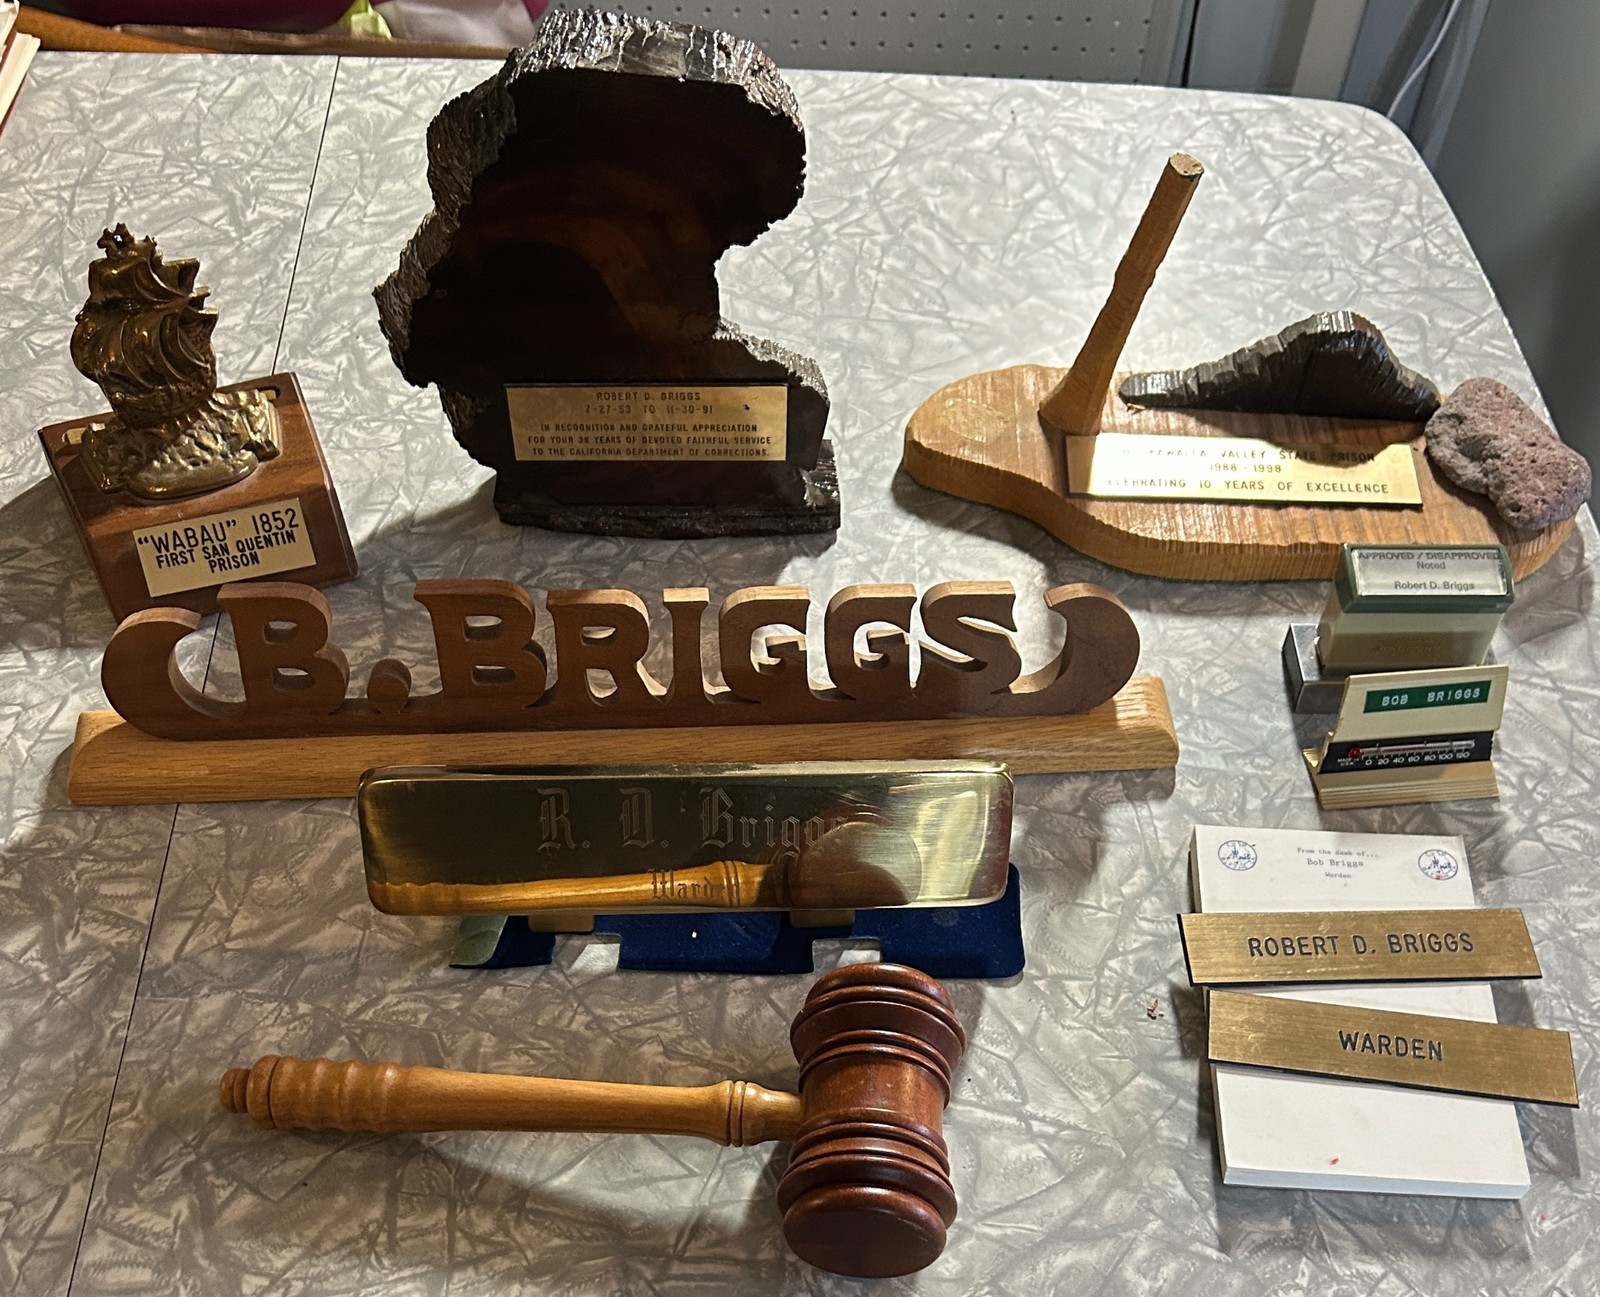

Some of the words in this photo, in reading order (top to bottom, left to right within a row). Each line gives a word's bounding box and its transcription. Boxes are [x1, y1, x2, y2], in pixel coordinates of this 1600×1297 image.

[596, 392, 638, 400] ROBERT
[644, 392, 655, 400] D.
[660, 392, 701, 400] BRIGGS
[586, 404, 632, 414] 7-27-53
[643, 404, 656, 414] TO
[666, 404, 713, 414] 11-30-91
[540, 424, 550, 432] IN
[554, 424, 615, 432] RECOGNITION
[620, 424, 638, 432] AND
[642, 424, 689, 432] GRATEFUL
[692, 424, 758, 432] APPRECIATION
[527, 436, 545, 444] FOR
[550, 436, 574, 444] YOUR
[594, 436, 621, 444] YEARS
[626, 436, 636, 444] OF
[642, 436, 682, 444] DEVOTED
[686, 436, 730, 445] FAITHFUL
[734, 436, 772, 445] SERVICE
[532, 447, 544, 456] TO
[548, 447, 566, 456] THE
[569, 447, 622, 456] CALIFORNIA
[626, 448, 684, 456] DEPARTMENT
[688, 448, 700, 456] OF
[704, 448, 770, 457] CORRECTIONS.
[1221, 449, 1266, 459] VALLEY
[1279, 450, 1316, 460] STATE
[1330, 451, 1375, 462] PRISON
[1210, 463, 1237, 472] 1988
[1253, 464, 1282, 473] 1998
[1107, 478, 1187, 488] ELEBRATING
[1200, 480, 1212, 489] 10
[1224, 480, 1265, 490] YEARS
[1277, 482, 1293, 492] OF
[1306, 482, 1390, 494] EXCELLENCE
[252, 507, 299, 535] 1852
[155, 549, 195, 569] FIRST
[202, 542, 230, 560] SAN
[235, 529, 297, 553] QUENTIN
[208, 552, 260, 573] PRISON
[1358, 552, 1415, 560] APPROVED
[1426, 552, 1501, 561] DISAPPROVED
[1416, 561, 1446, 570] Noted
[1394, 581, 1427, 590] Robert
[1429, 581, 1439, 590] D.
[1442, 581, 1475, 592] Briggs
[1381, 694, 1409, 707] BOB
[1426, 688, 1480, 703] BRIGGS
[1378, 758, 1390, 766] 20
[1392, 756, 1405, 764] 40
[1408, 754, 1420, 763] 60
[1424, 754, 1436, 762] 80
[1438, 752, 1454, 761] 100
[1456, 750, 1470, 760] 120
[535, 786, 591, 855] R.
[619, 787, 669, 849] D.
[1297, 847, 1316, 855] From
[1306, 857, 1324, 866] Bob
[1329, 859, 1364, 869] Briggs
[1324, 871, 1352, 880] Warden
[647, 867, 742, 900] Ward
[1247, 934, 1339, 958] ROBERT
[1352, 934, 1377, 956] D.
[1386, 932, 1475, 955] BRIGGS
[1338, 1029, 1444, 1062] WARDEN
